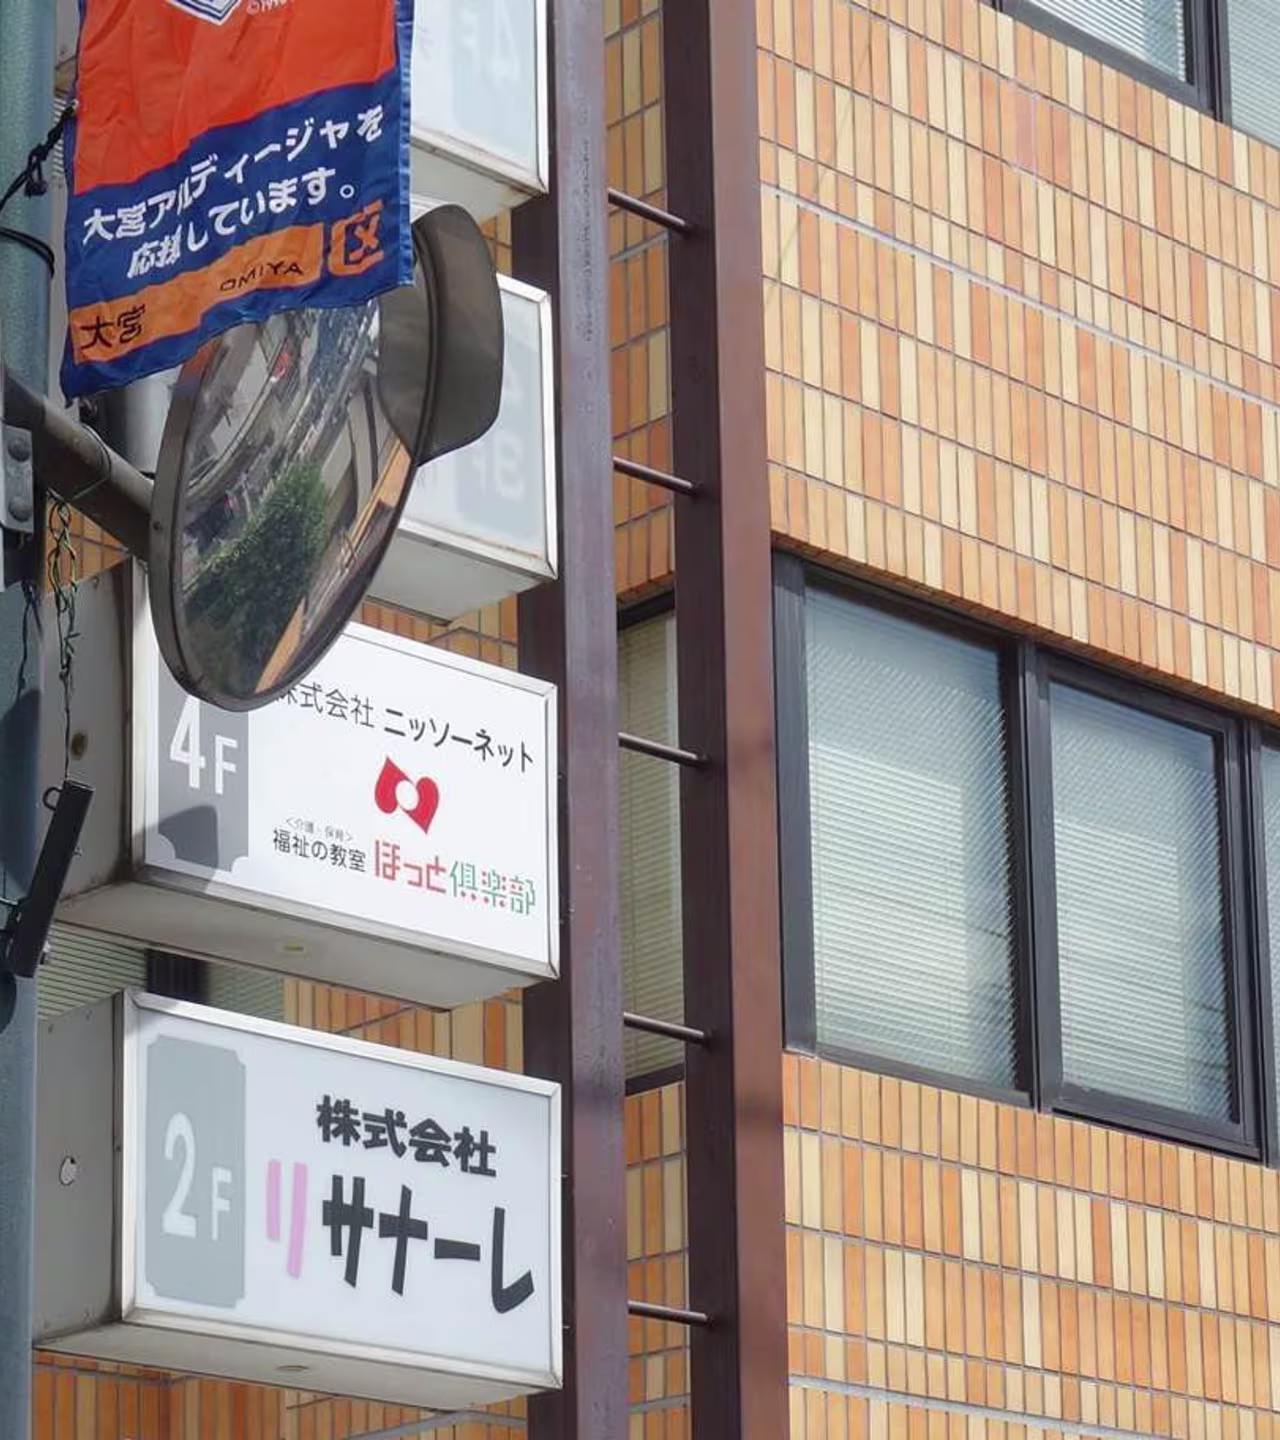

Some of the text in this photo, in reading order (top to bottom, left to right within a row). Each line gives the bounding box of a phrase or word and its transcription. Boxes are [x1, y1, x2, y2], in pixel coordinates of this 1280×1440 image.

[82, 104, 384, 246] 大宮アルディージャを
[126, 165, 355, 278] 応援しています。
[80, 200, 384, 349] 大宮 OMIYA 区
[168, 694, 238, 795] 4F
[383, 707, 534, 773] ニッソーネット
[273, 828, 536, 916] 福祉の教室 ほっと倶楽部
[162, 1111, 233, 1242] 2F
[316, 1094, 498, 1178] 株式会社
[265, 1158, 535, 1315] リサナーレ
